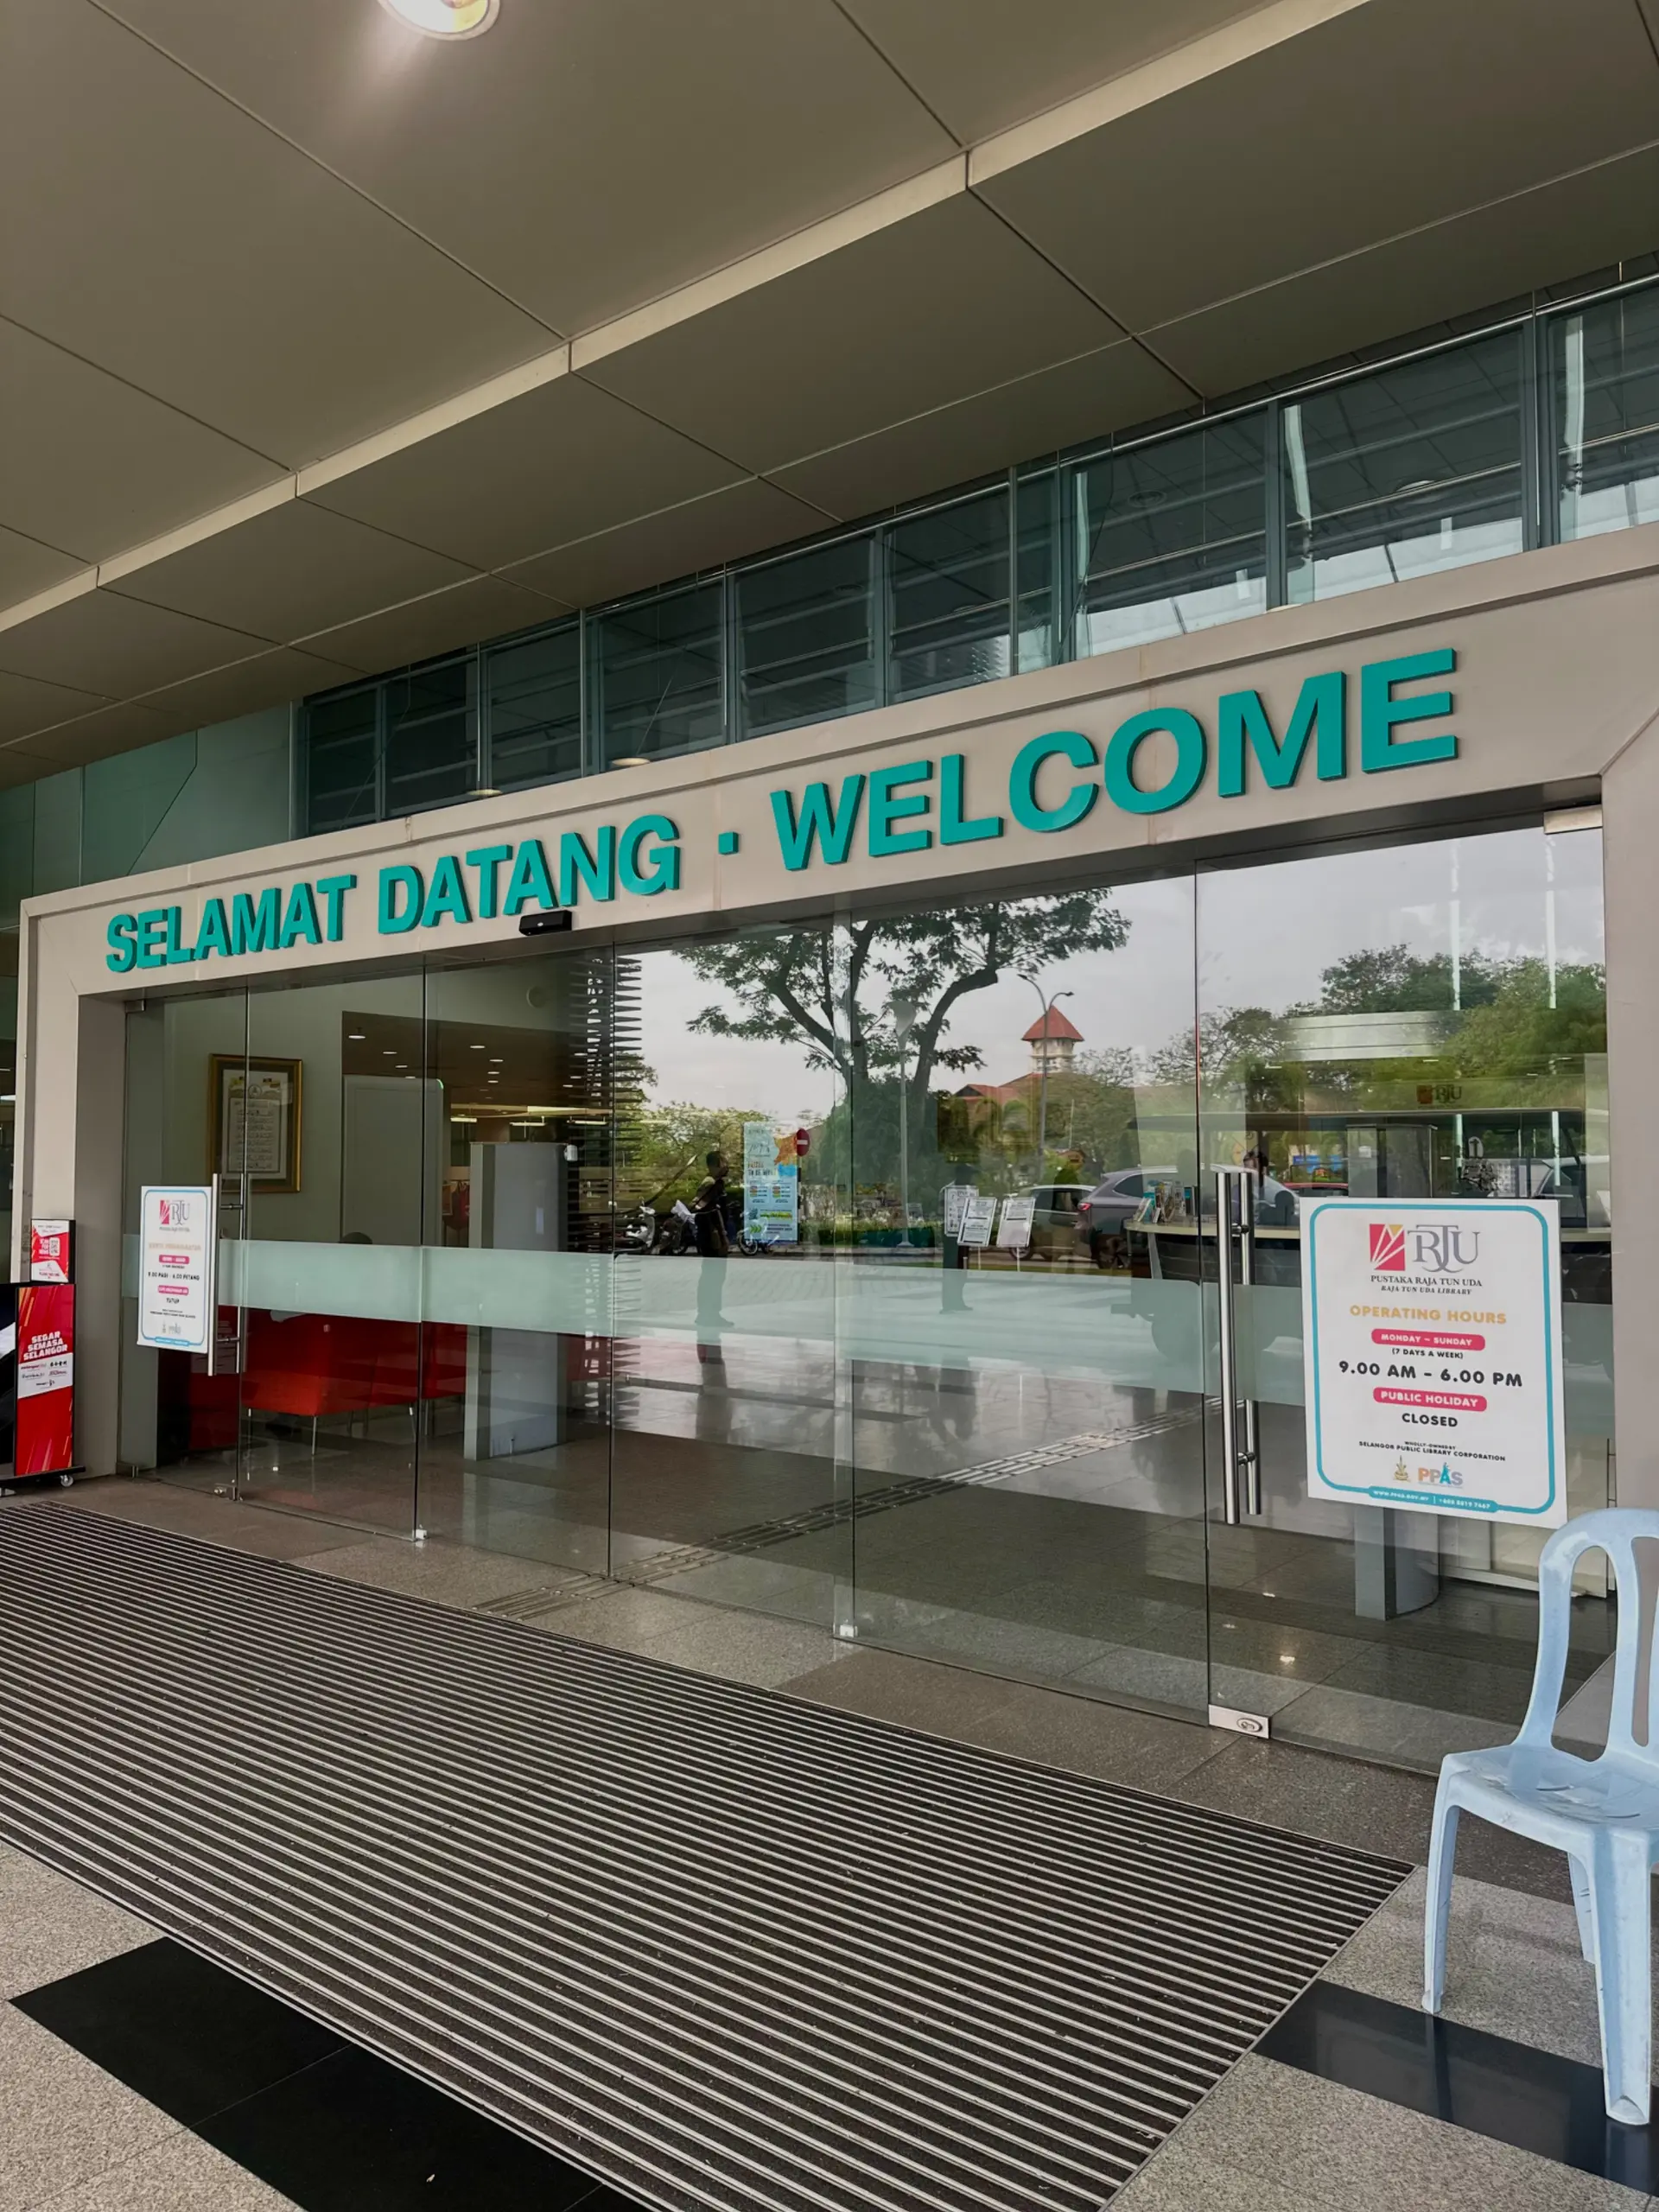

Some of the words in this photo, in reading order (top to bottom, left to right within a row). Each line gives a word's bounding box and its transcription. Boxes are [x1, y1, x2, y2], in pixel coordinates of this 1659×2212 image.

[106, 874, 357, 973] SELAMAT
[378, 814, 680, 934] DATANG
[770, 648, 1458, 871] WELCOME
[1370, 1274, 1414, 1285] PUSTAKA
[1414, 1276, 1438, 1287] RAJA
[1440, 1277, 1460, 1287] TUN
[1462, 1279, 1483, 1287] UDA
[1437, 1287, 1472, 1295] LIBRARY
[1349, 1305, 1441, 1321] OPERATING
[1447, 1310, 1507, 1325] HOURS
[28, 1338, 64, 1352] SEMASA
[31, 1331, 60, 1344] SEGAR
[1381, 1333, 1421, 1343] MONDAY
[1433, 1337, 1472, 1346] SUNDAY
[23, 1344, 68, 1361] SELANGOR
[1391, 1347, 1400, 1356] (7
[1436, 1351, 1464, 1359] WEEK)
[1338, 1360, 1380, 1376] 9.00
[1387, 1364, 1416, 1379] AM
[1440, 1368, 1484, 1384] 6.00
[1492, 1371, 1522, 1388] PM
[1380, 1390, 1421, 1403] PUBLIC
[1425, 1394, 1478, 1408] HOLIDAY
[1402, 1413, 1459, 1427] CLOSED
[1358, 1441, 1395, 1450] SELANGOR
[1422, 1447, 1452, 1456] LIBRARY
[1453, 1451, 1506, 1461] CORPORATION
[1417, 1463, 1464, 1486] PPAS
